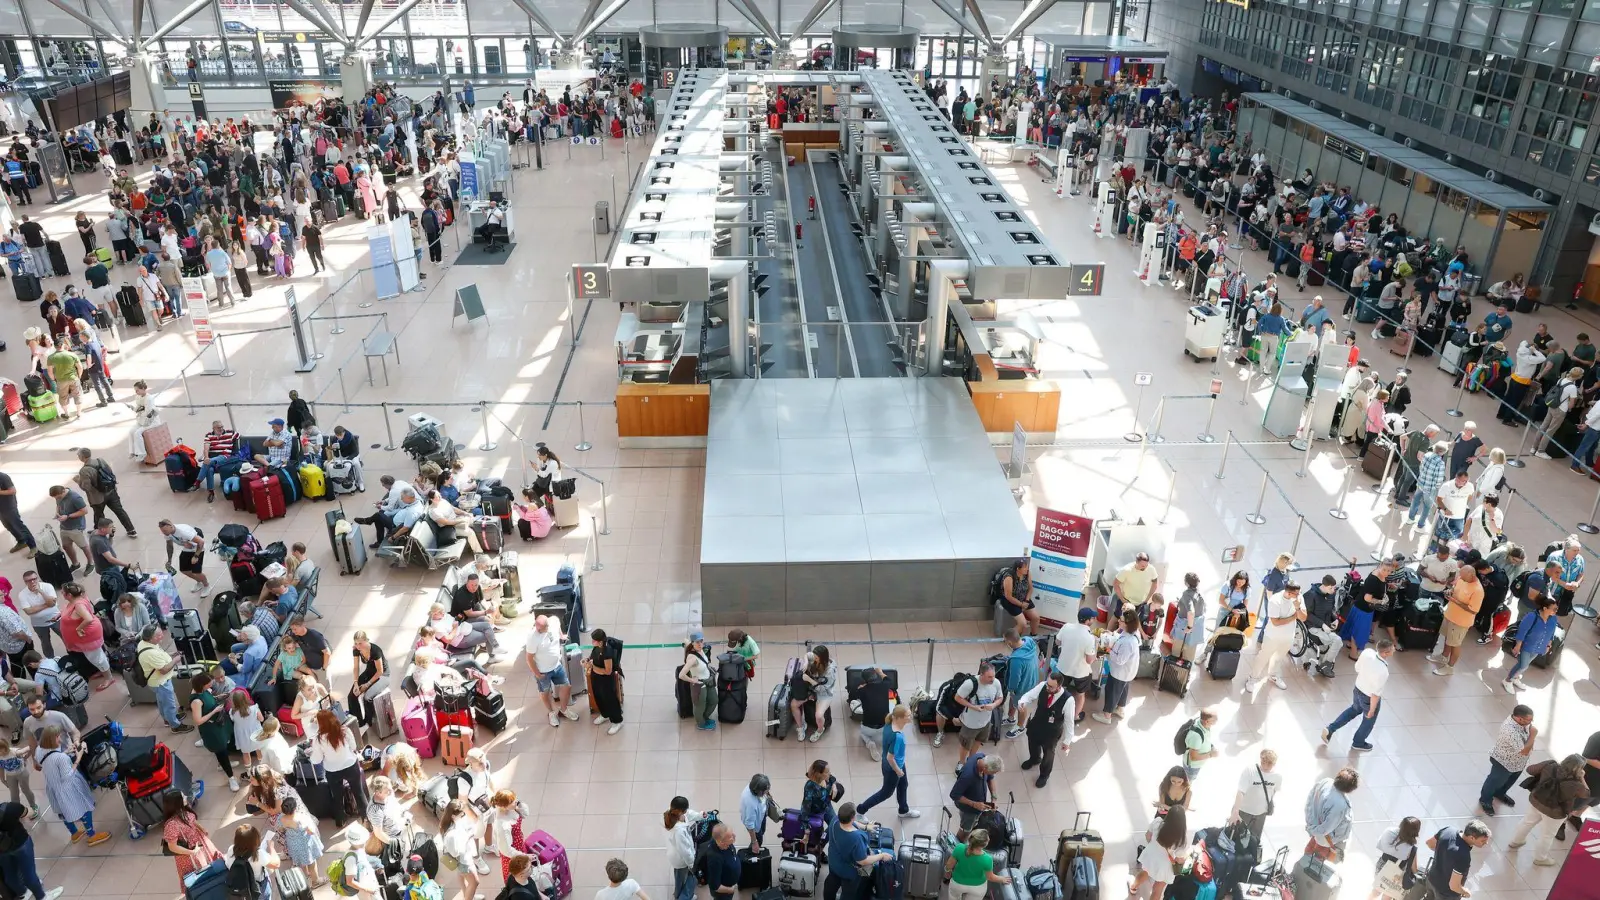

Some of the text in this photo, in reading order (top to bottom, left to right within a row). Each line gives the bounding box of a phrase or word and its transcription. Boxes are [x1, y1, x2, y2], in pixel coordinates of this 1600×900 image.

[666, 71, 674, 82] 3
[913, 72, 920, 83] 4
[583, 271, 597, 290] 3
[1080, 269, 1094, 287] 4
[1038, 531, 1062, 542] DROP
[1039, 523, 1082, 539] BAGGAGE
